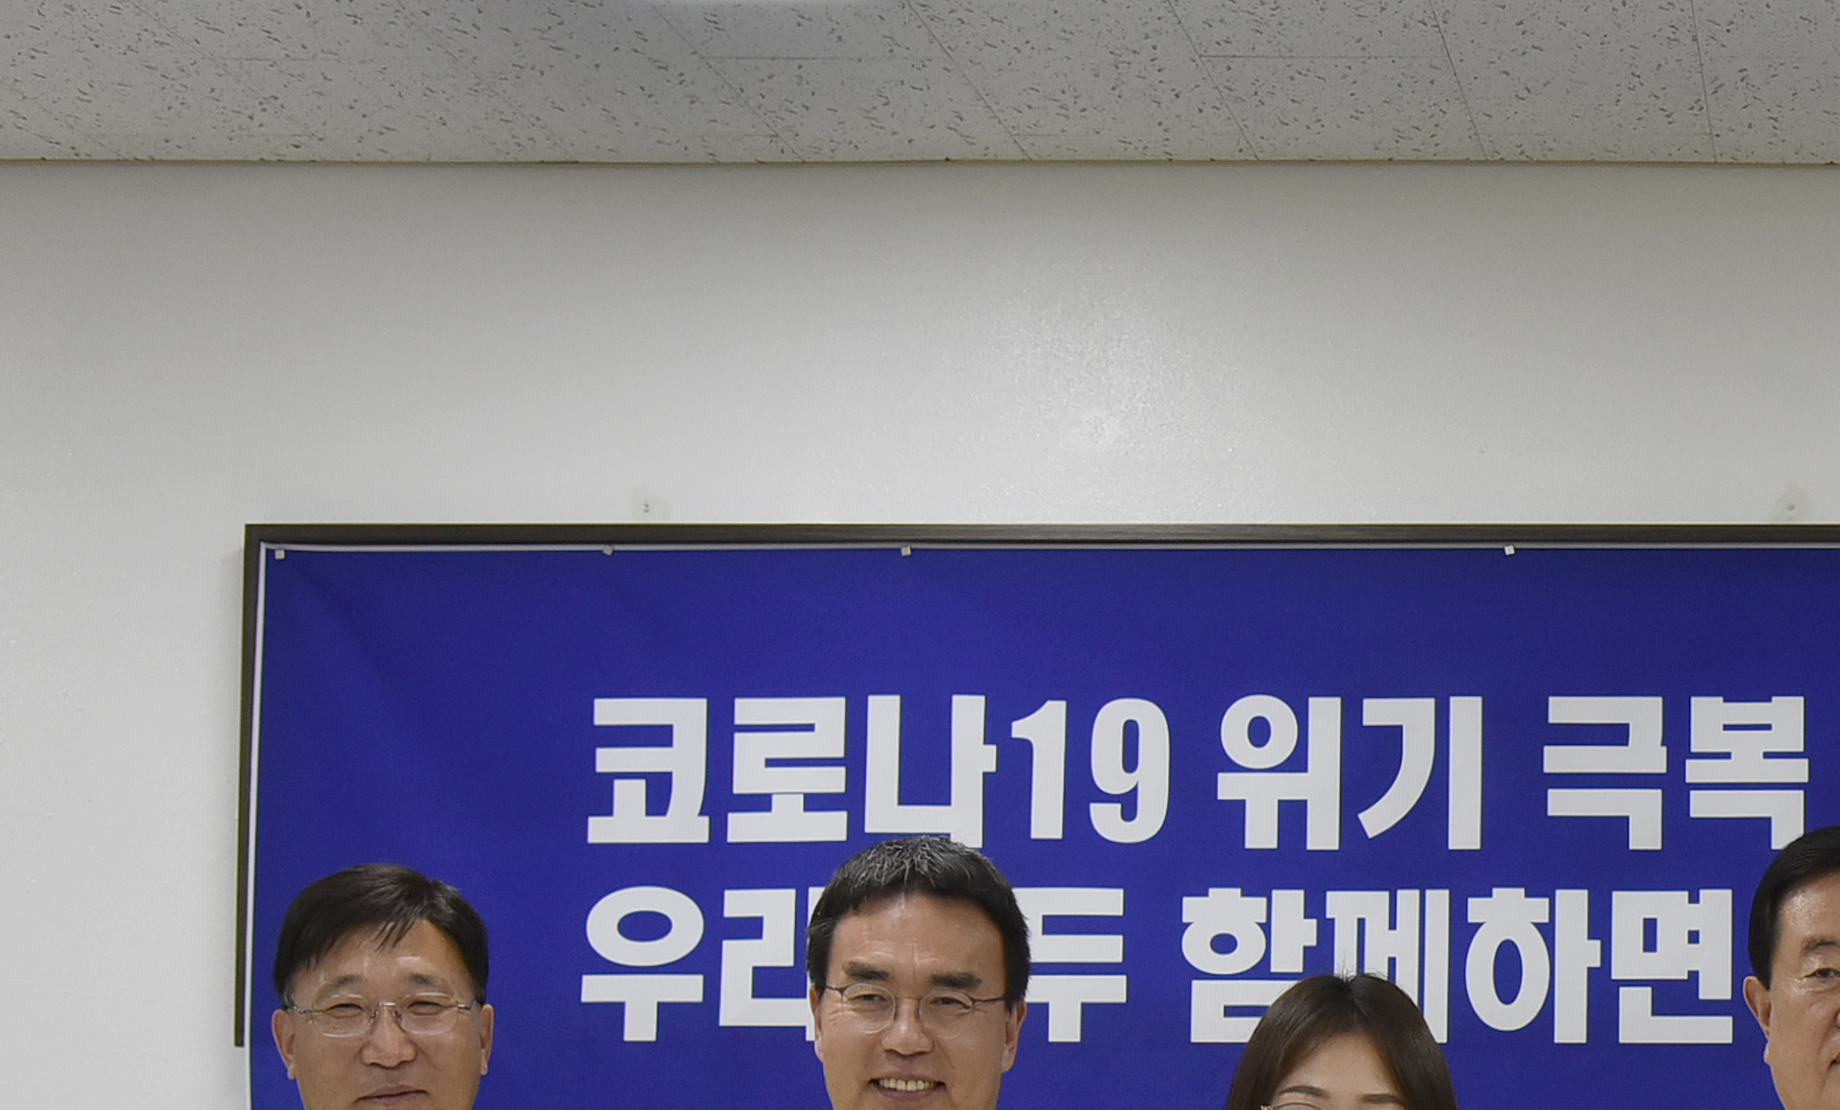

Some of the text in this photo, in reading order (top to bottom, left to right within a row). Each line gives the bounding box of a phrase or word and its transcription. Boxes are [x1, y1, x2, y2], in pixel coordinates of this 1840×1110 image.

[587, 694, 1809, 850] 코로나19 위기 극복
[1181, 887, 1733, 1043] 함께하면
